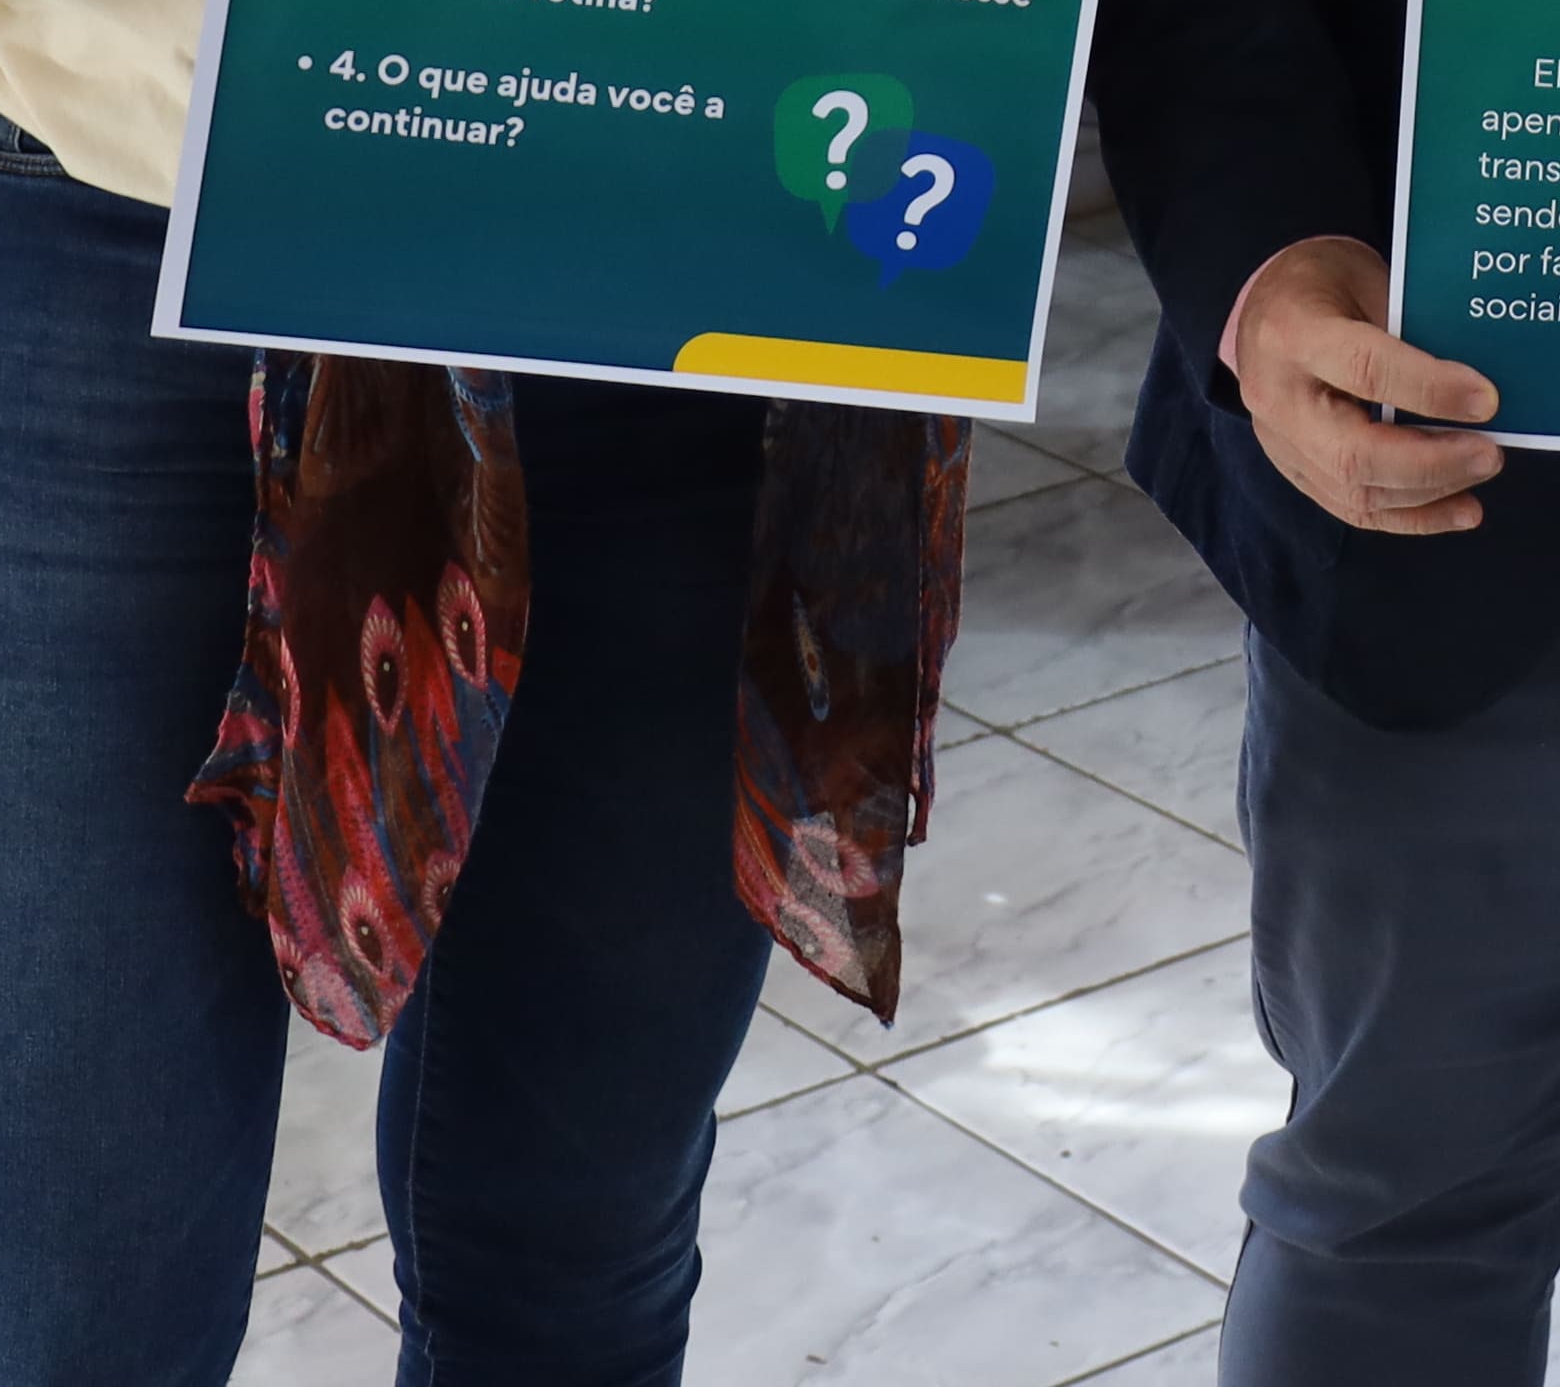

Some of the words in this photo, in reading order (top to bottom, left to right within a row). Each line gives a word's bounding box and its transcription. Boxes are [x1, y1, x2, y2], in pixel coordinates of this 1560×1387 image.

[328, 50, 366, 83] 4.
[377, 54, 410, 86] O
[418, 66, 489, 99] que
[496, 67, 597, 107] ajuda
[607, 84, 696, 116] você
[704, 96, 725, 120] a
[324, 105, 525, 148] continuar?
[1472, 250, 1532, 279] por
